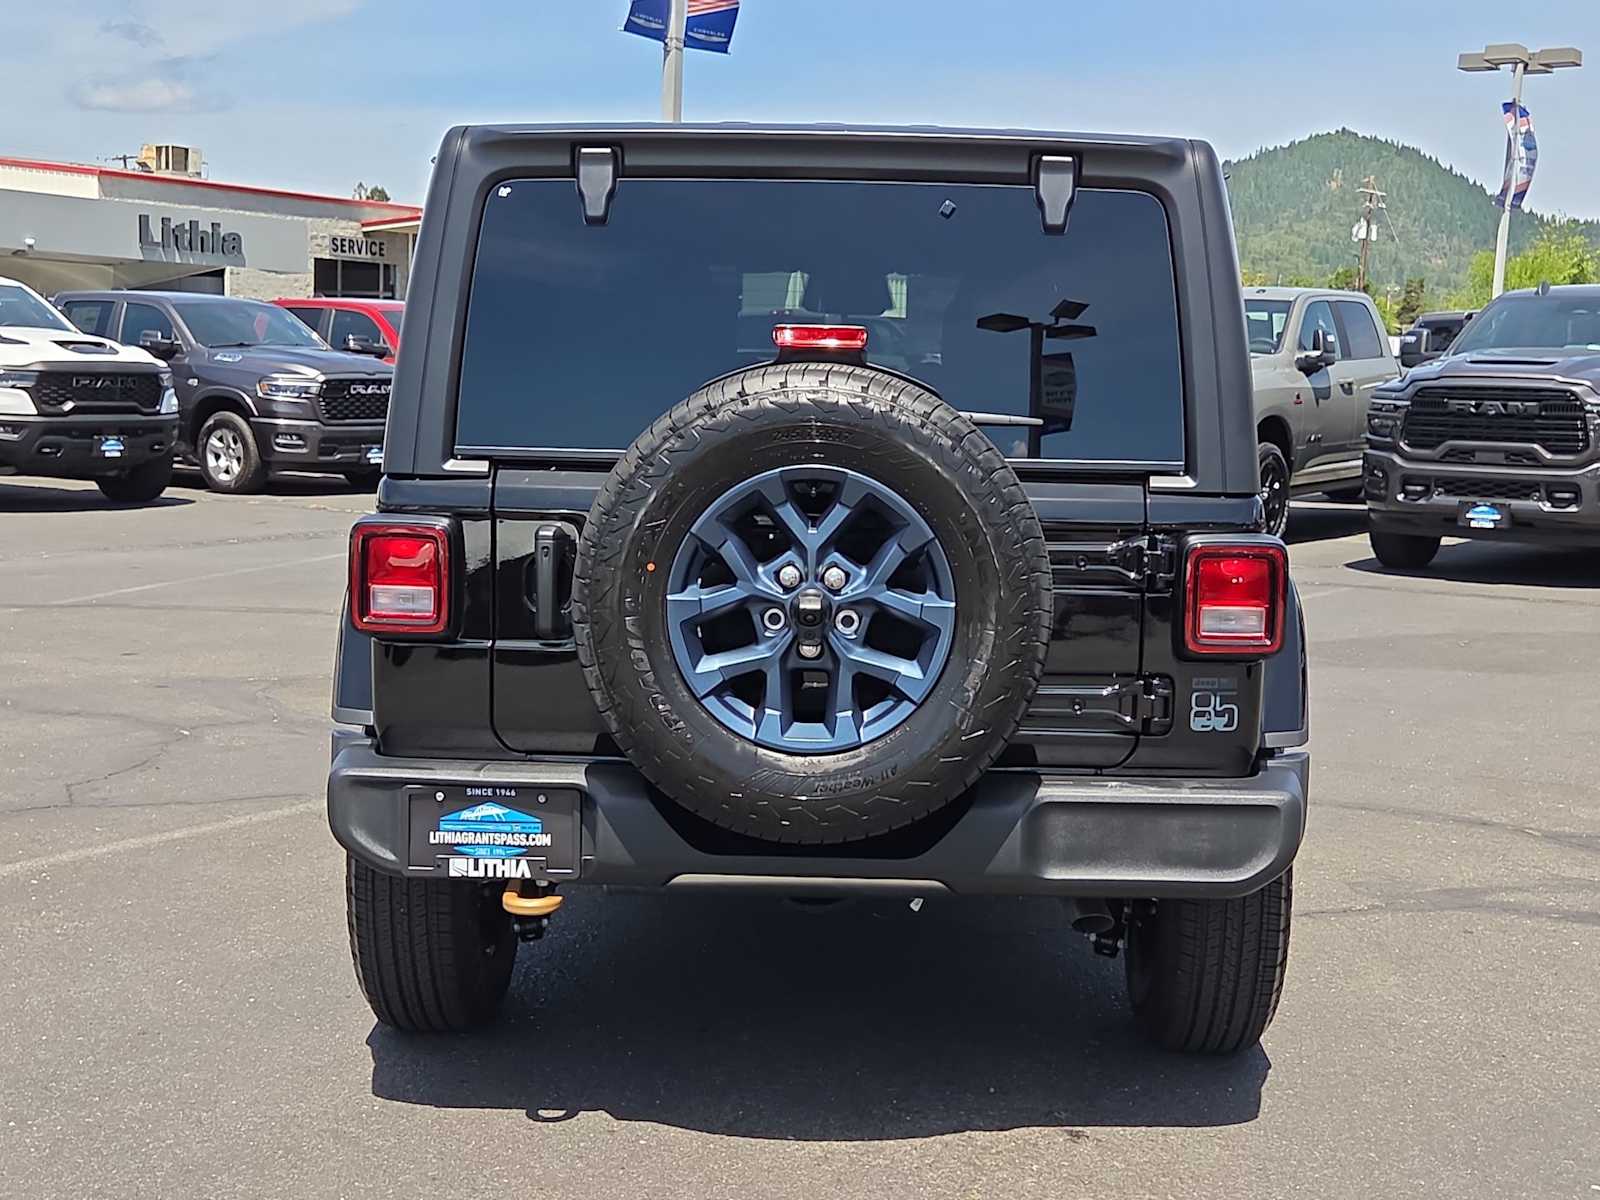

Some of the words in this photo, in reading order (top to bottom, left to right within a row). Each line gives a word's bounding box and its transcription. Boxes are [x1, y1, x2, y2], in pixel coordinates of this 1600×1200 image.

[138, 214, 242, 256] Lithia
[331, 237, 385, 257] SERVICE
[466, 787, 493, 796] SINCE
[496, 788, 516, 797] 1946
[429, 830, 551, 847] LITHIAGRANTSPASS.COM
[468, 857, 532, 879] LITHIA
